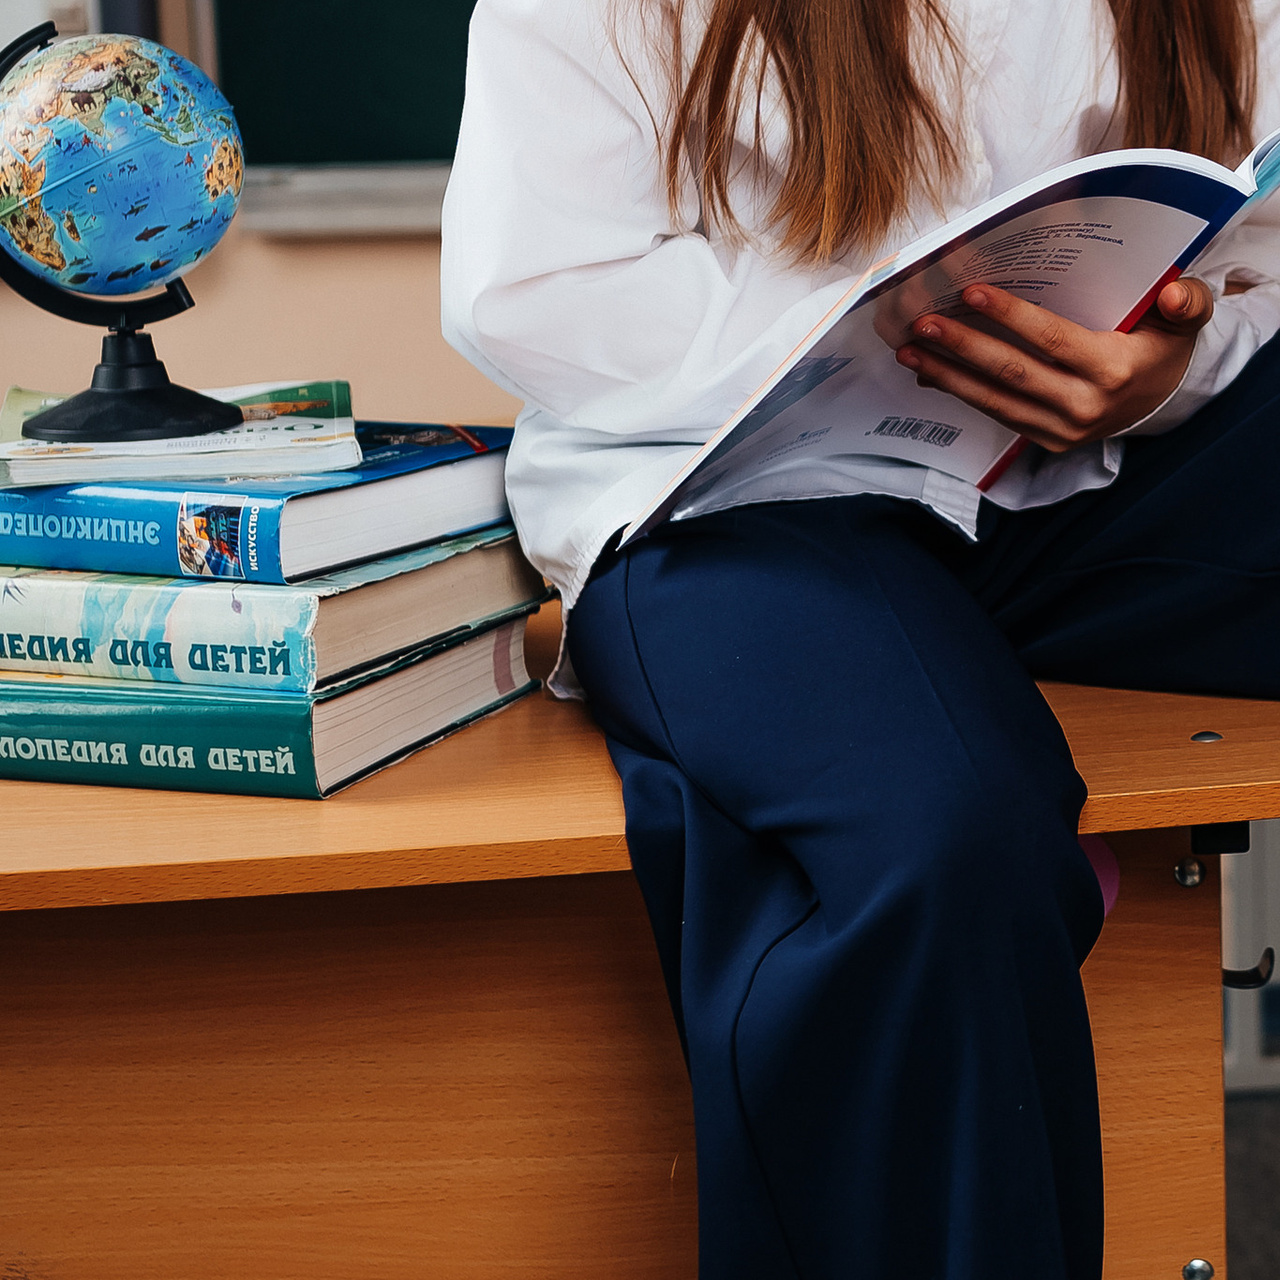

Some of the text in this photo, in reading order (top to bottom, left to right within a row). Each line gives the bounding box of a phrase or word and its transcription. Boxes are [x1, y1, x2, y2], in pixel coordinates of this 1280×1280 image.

[1075, 233, 1125, 246] Вербицкой,
[248, 505, 260, 571] ИСКУССТВО
[109, 638, 175, 670] ДЛЯ
[187, 639, 292, 676] ДЕТЕЙ
[139, 743, 195, 770] ДЛЯ
[207, 746, 297, 776] ДЕТЕЙ
